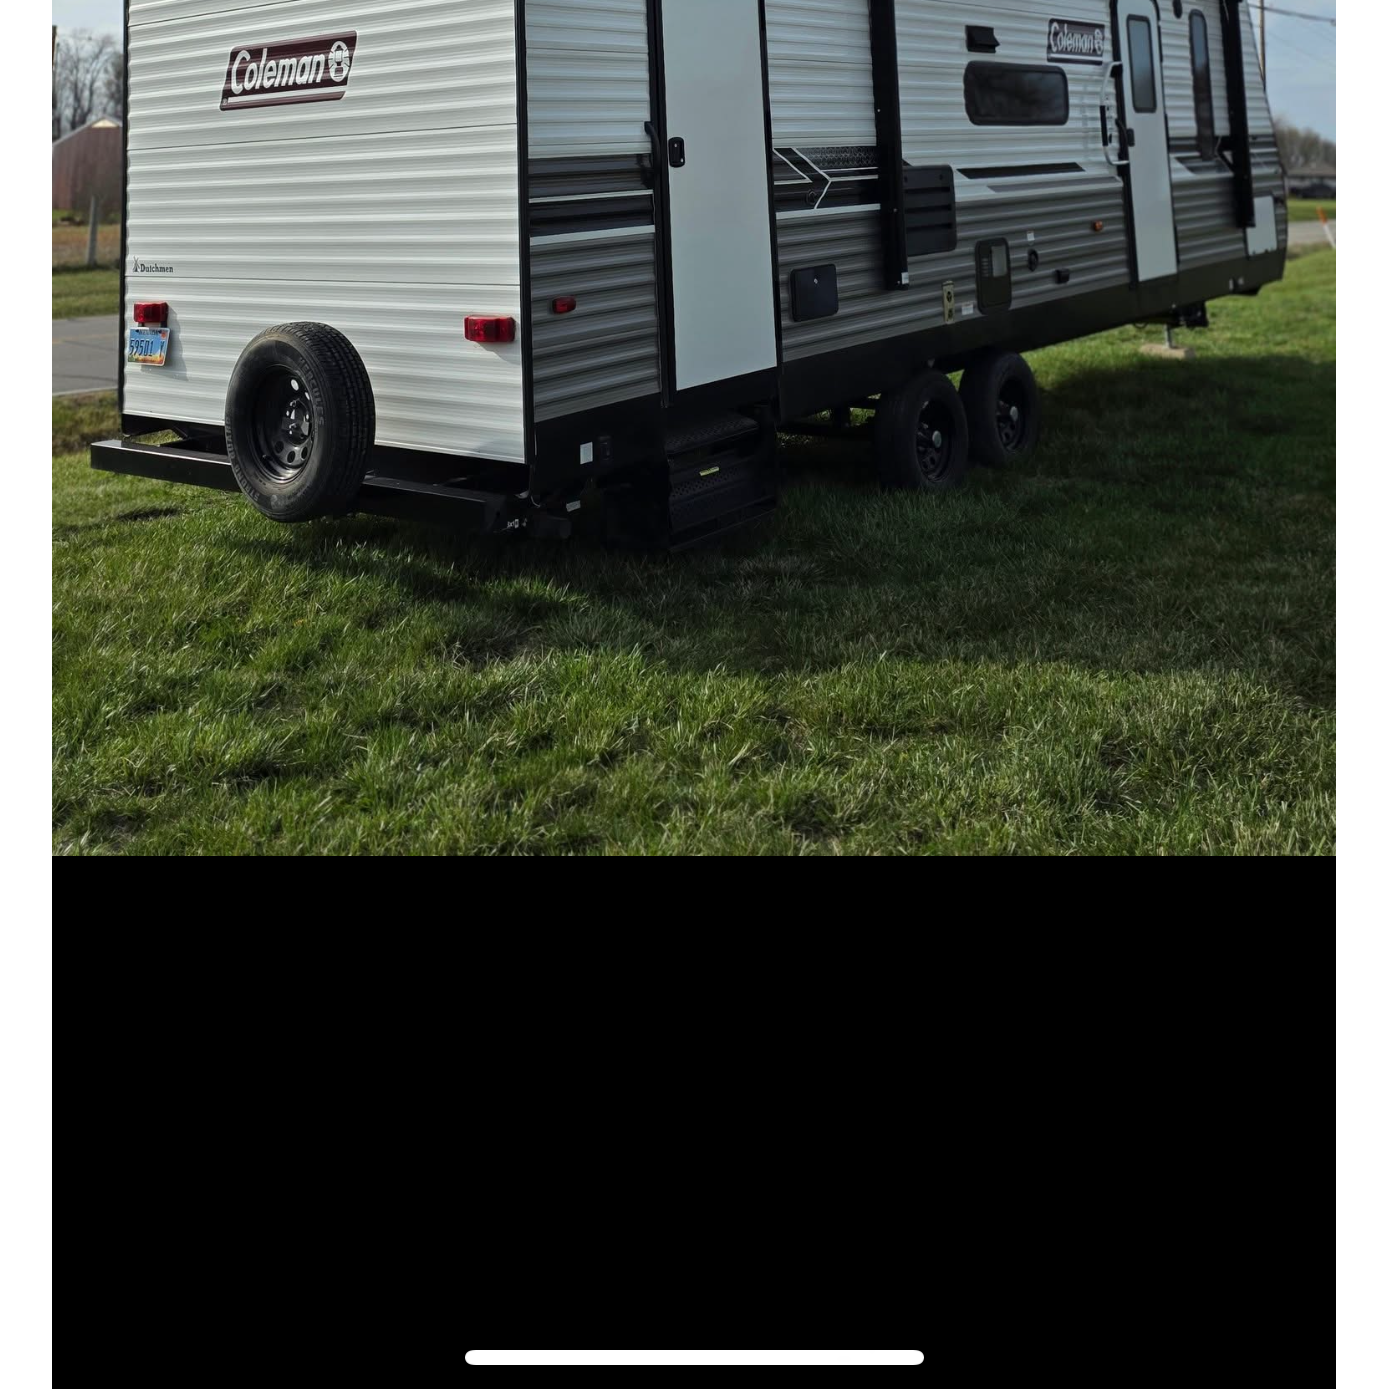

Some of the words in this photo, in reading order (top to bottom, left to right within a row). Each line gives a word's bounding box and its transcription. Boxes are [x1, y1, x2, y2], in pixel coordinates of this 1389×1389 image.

[1050, 22, 1094, 53] Coleman
[231, 48, 326, 95] Coleman
[140, 263, 174, 272] Dutchmen
[297, 357, 325, 426] HERCULES
